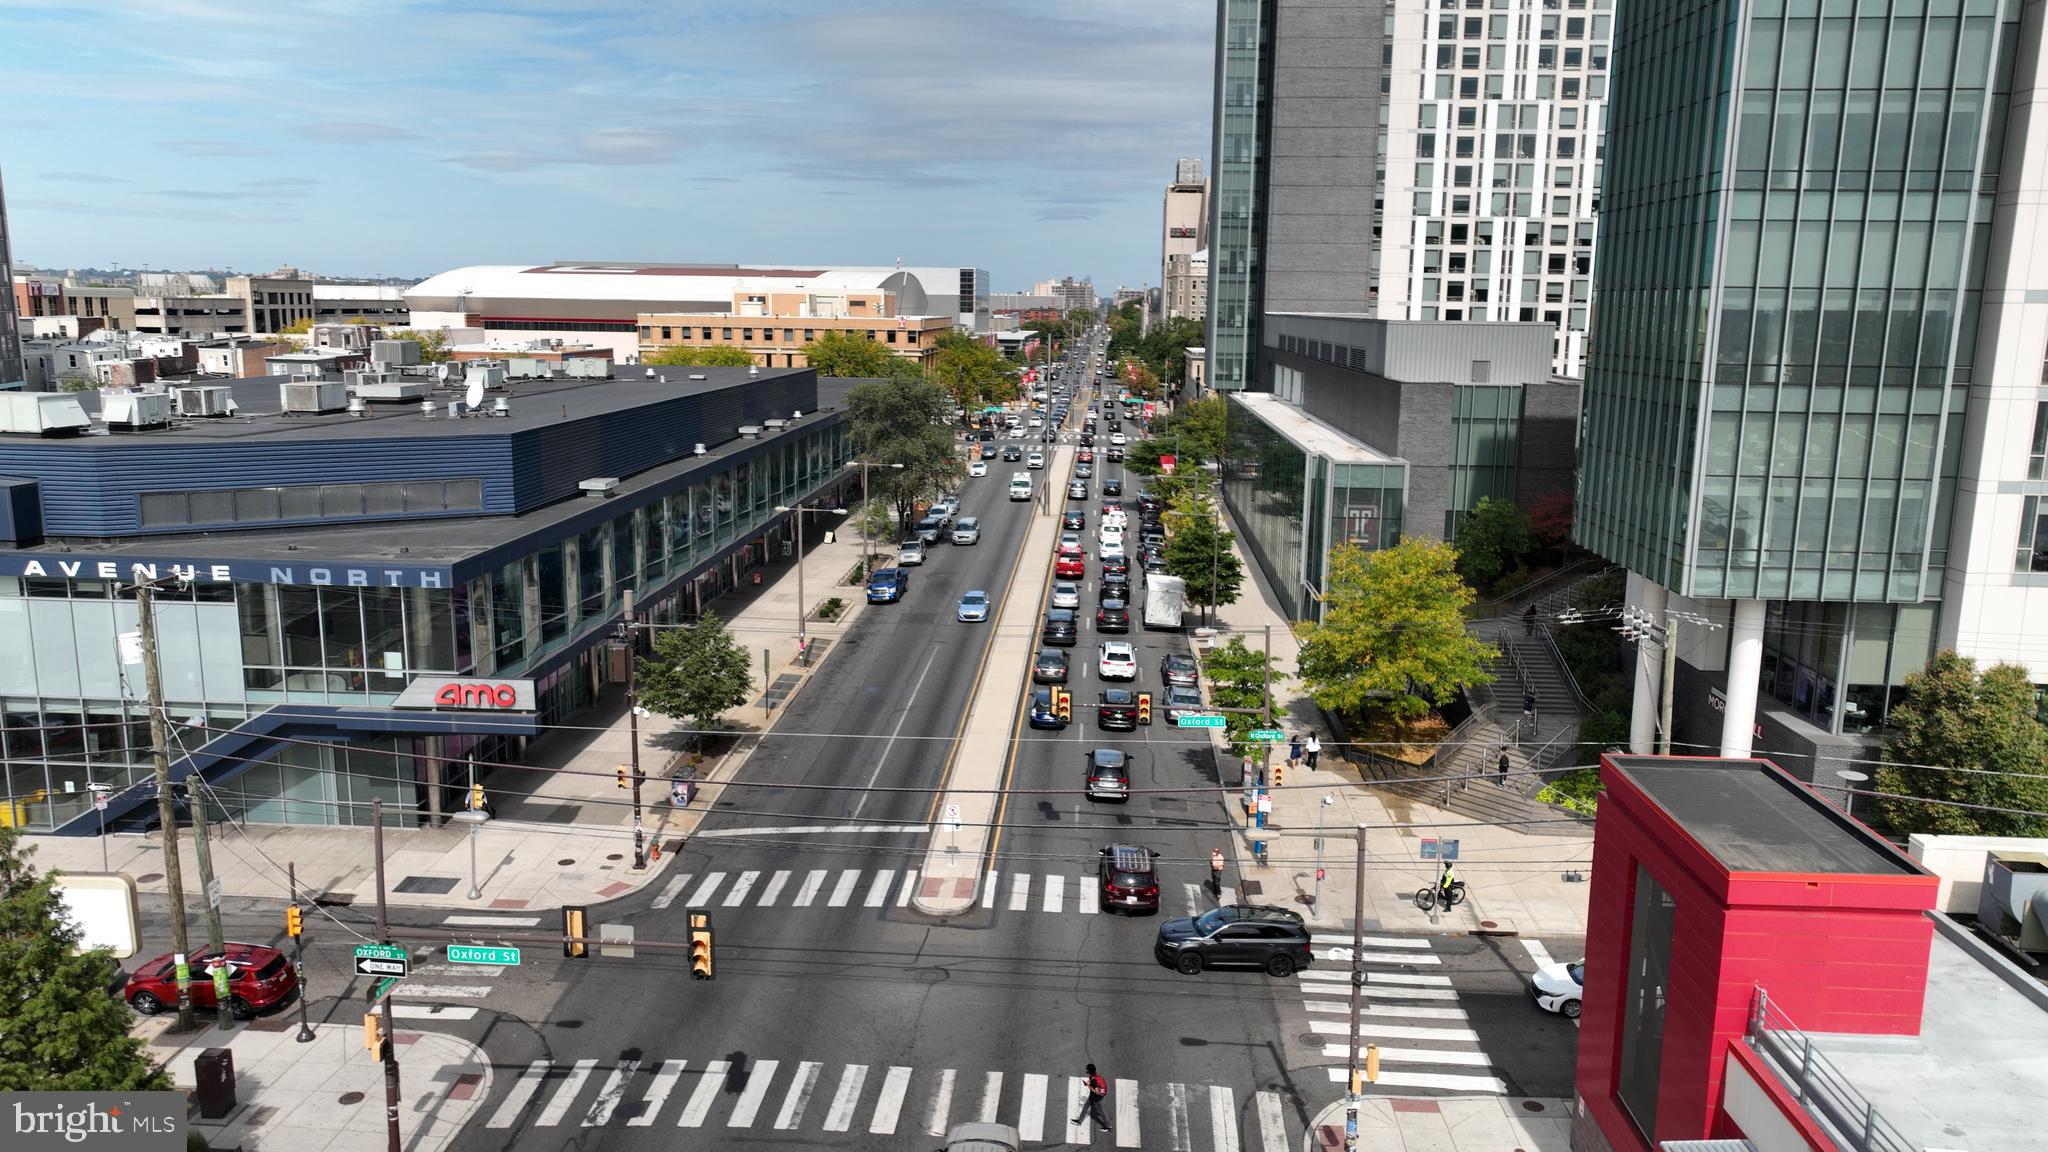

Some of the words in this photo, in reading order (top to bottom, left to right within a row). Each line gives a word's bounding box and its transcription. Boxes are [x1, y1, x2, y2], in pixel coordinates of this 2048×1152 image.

[24, 559, 231, 581] AVENUE
[270, 567, 442, 588] NORTH
[1180, 718, 1210, 726] Oxford
[1214, 718, 1223, 726] St
[356, 948, 391, 958] OXFORD
[451, 949, 496, 961] Oxford
[502, 950, 516, 962] St
